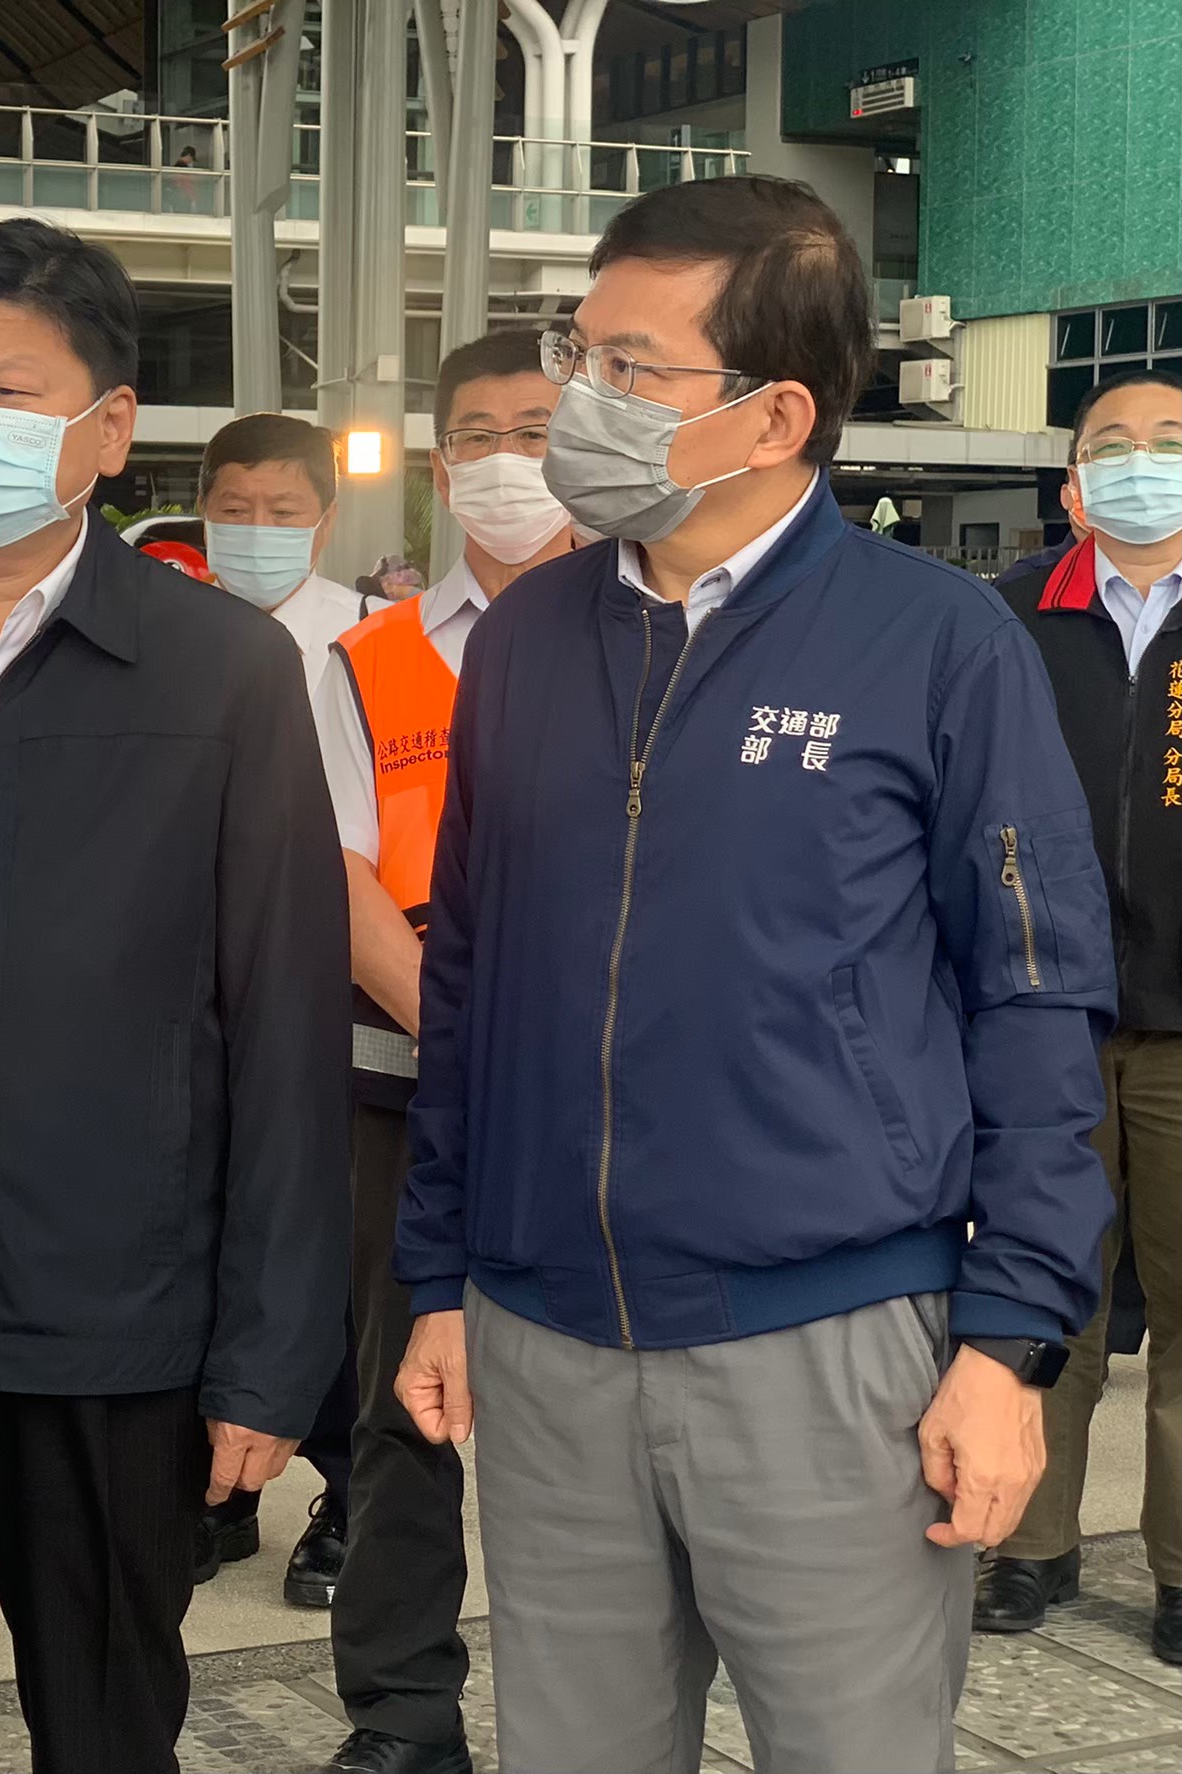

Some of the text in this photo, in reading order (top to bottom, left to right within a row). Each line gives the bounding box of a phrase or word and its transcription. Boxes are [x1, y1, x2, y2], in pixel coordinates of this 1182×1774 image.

[11, 433, 42, 446] YASCO
[748, 705, 841, 739] 交通部
